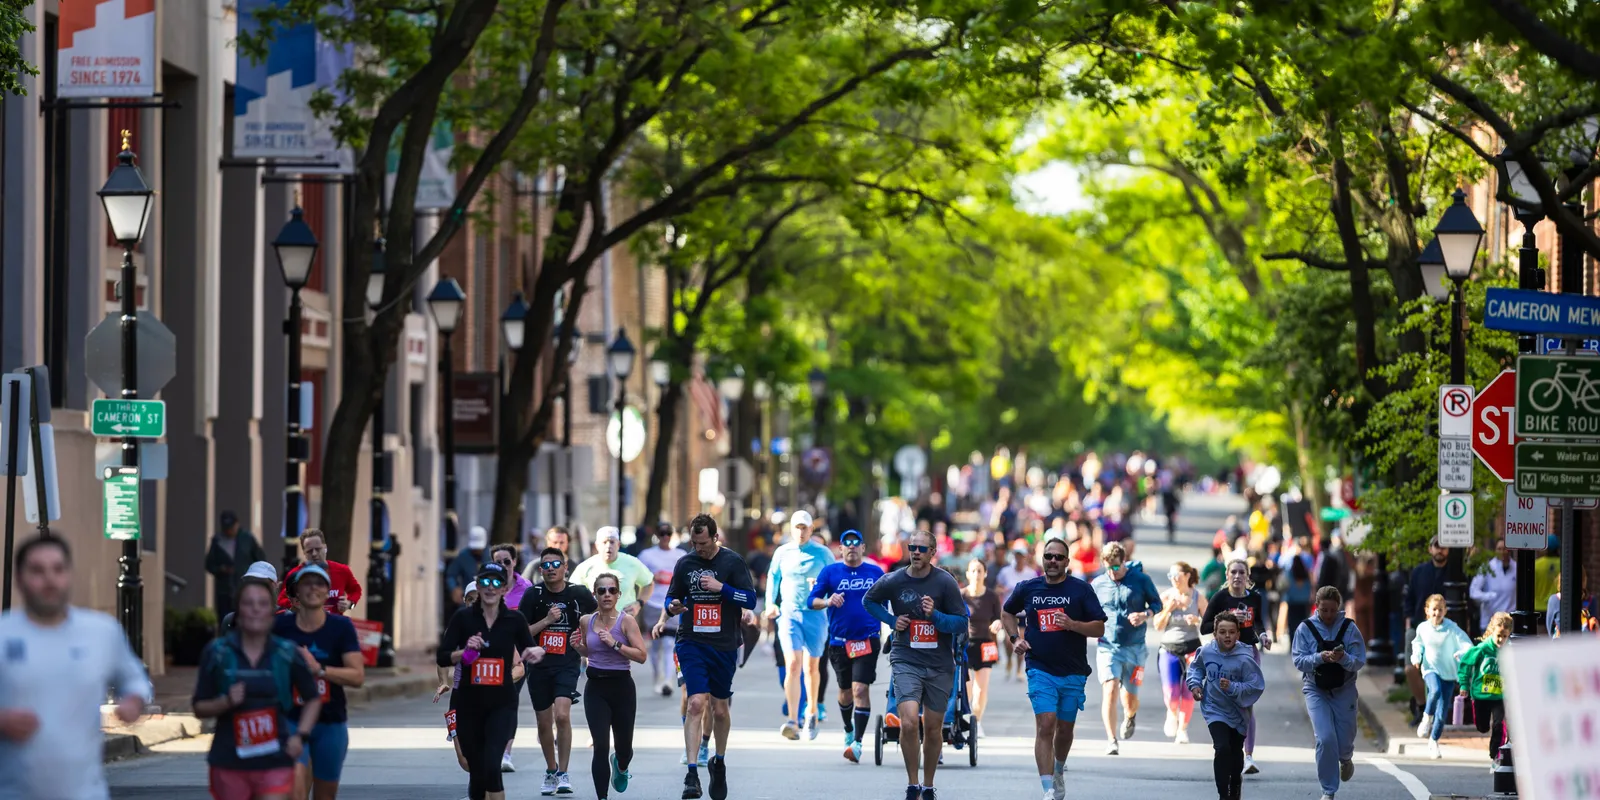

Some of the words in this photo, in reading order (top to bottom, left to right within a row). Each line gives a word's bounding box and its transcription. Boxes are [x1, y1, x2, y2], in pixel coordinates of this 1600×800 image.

[71, 56, 91, 66] FREE
[70, 70, 107, 84] SINCE
[112, 70, 141, 84] 1974
[1487, 299, 1561, 323] CAMERON
[116, 403, 137, 412] THRU
[141, 404, 147, 413] 5
[1452, 393, 1466, 411] P
[97, 412, 141, 423] CAMERON
[147, 413, 159, 424] ST
[1525, 415, 1560, 432] BIKE
[1567, 416, 1599, 432] ROU
[1479, 405, 1515, 445] ST
[1441, 441, 1452, 450] NO
[1455, 441, 1471, 450] BUS
[1556, 451, 1581, 461] Water
[1582, 451, 1599, 461] Taxi
[1540, 473, 1559, 486] King
[1560, 474, 1584, 484] Street
[1518, 496, 1534, 510] NO
[1507, 522, 1545, 535] PARKING
[328, 589, 339, 598] RY
[1032, 596, 1071, 605] RIVERON
[697, 608, 718, 620] 1615
[1040, 613, 1056, 625] 317
[914, 624, 935, 636] 1788
[543, 635, 564, 647] 1489
[850, 641, 866, 652] 209
[476, 663, 500, 678] 1111
